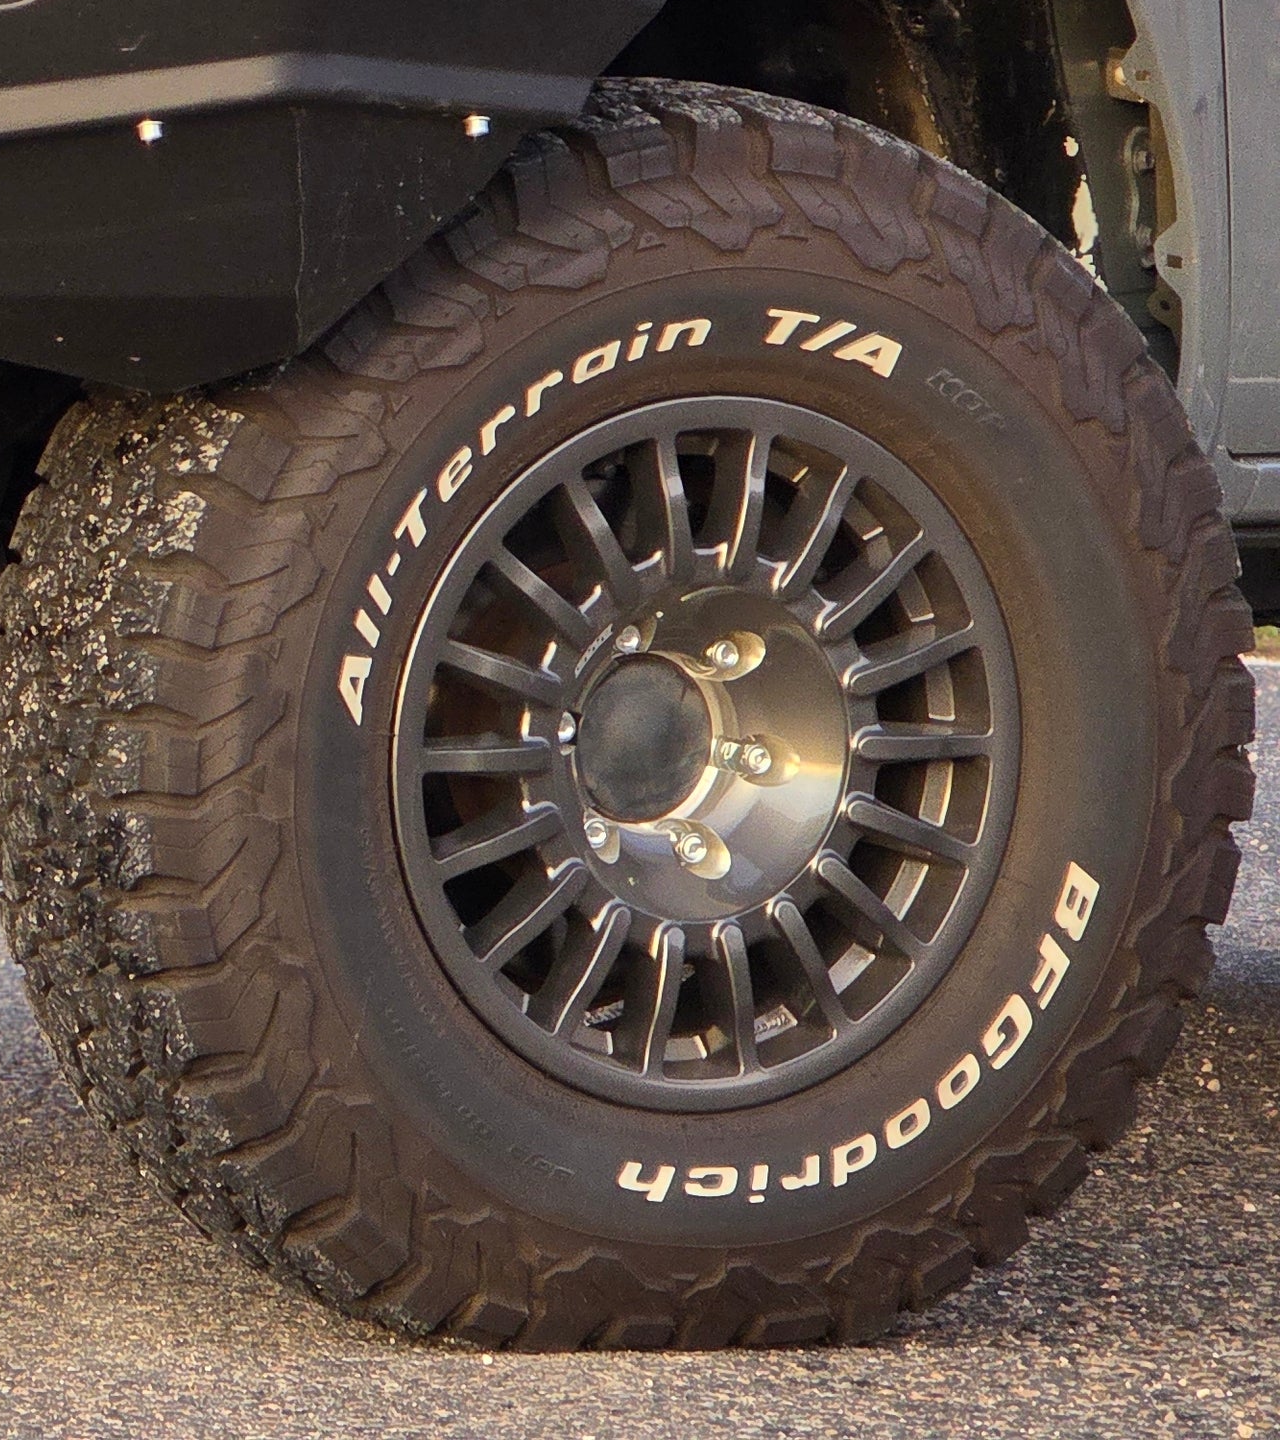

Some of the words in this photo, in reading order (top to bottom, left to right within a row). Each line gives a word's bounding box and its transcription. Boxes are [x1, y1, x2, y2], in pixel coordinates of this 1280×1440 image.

[338, 316, 713, 727] All-Terrain
[765, 307, 903, 379] T/A
[617, 861, 1101, 1205] BFGoodrich
